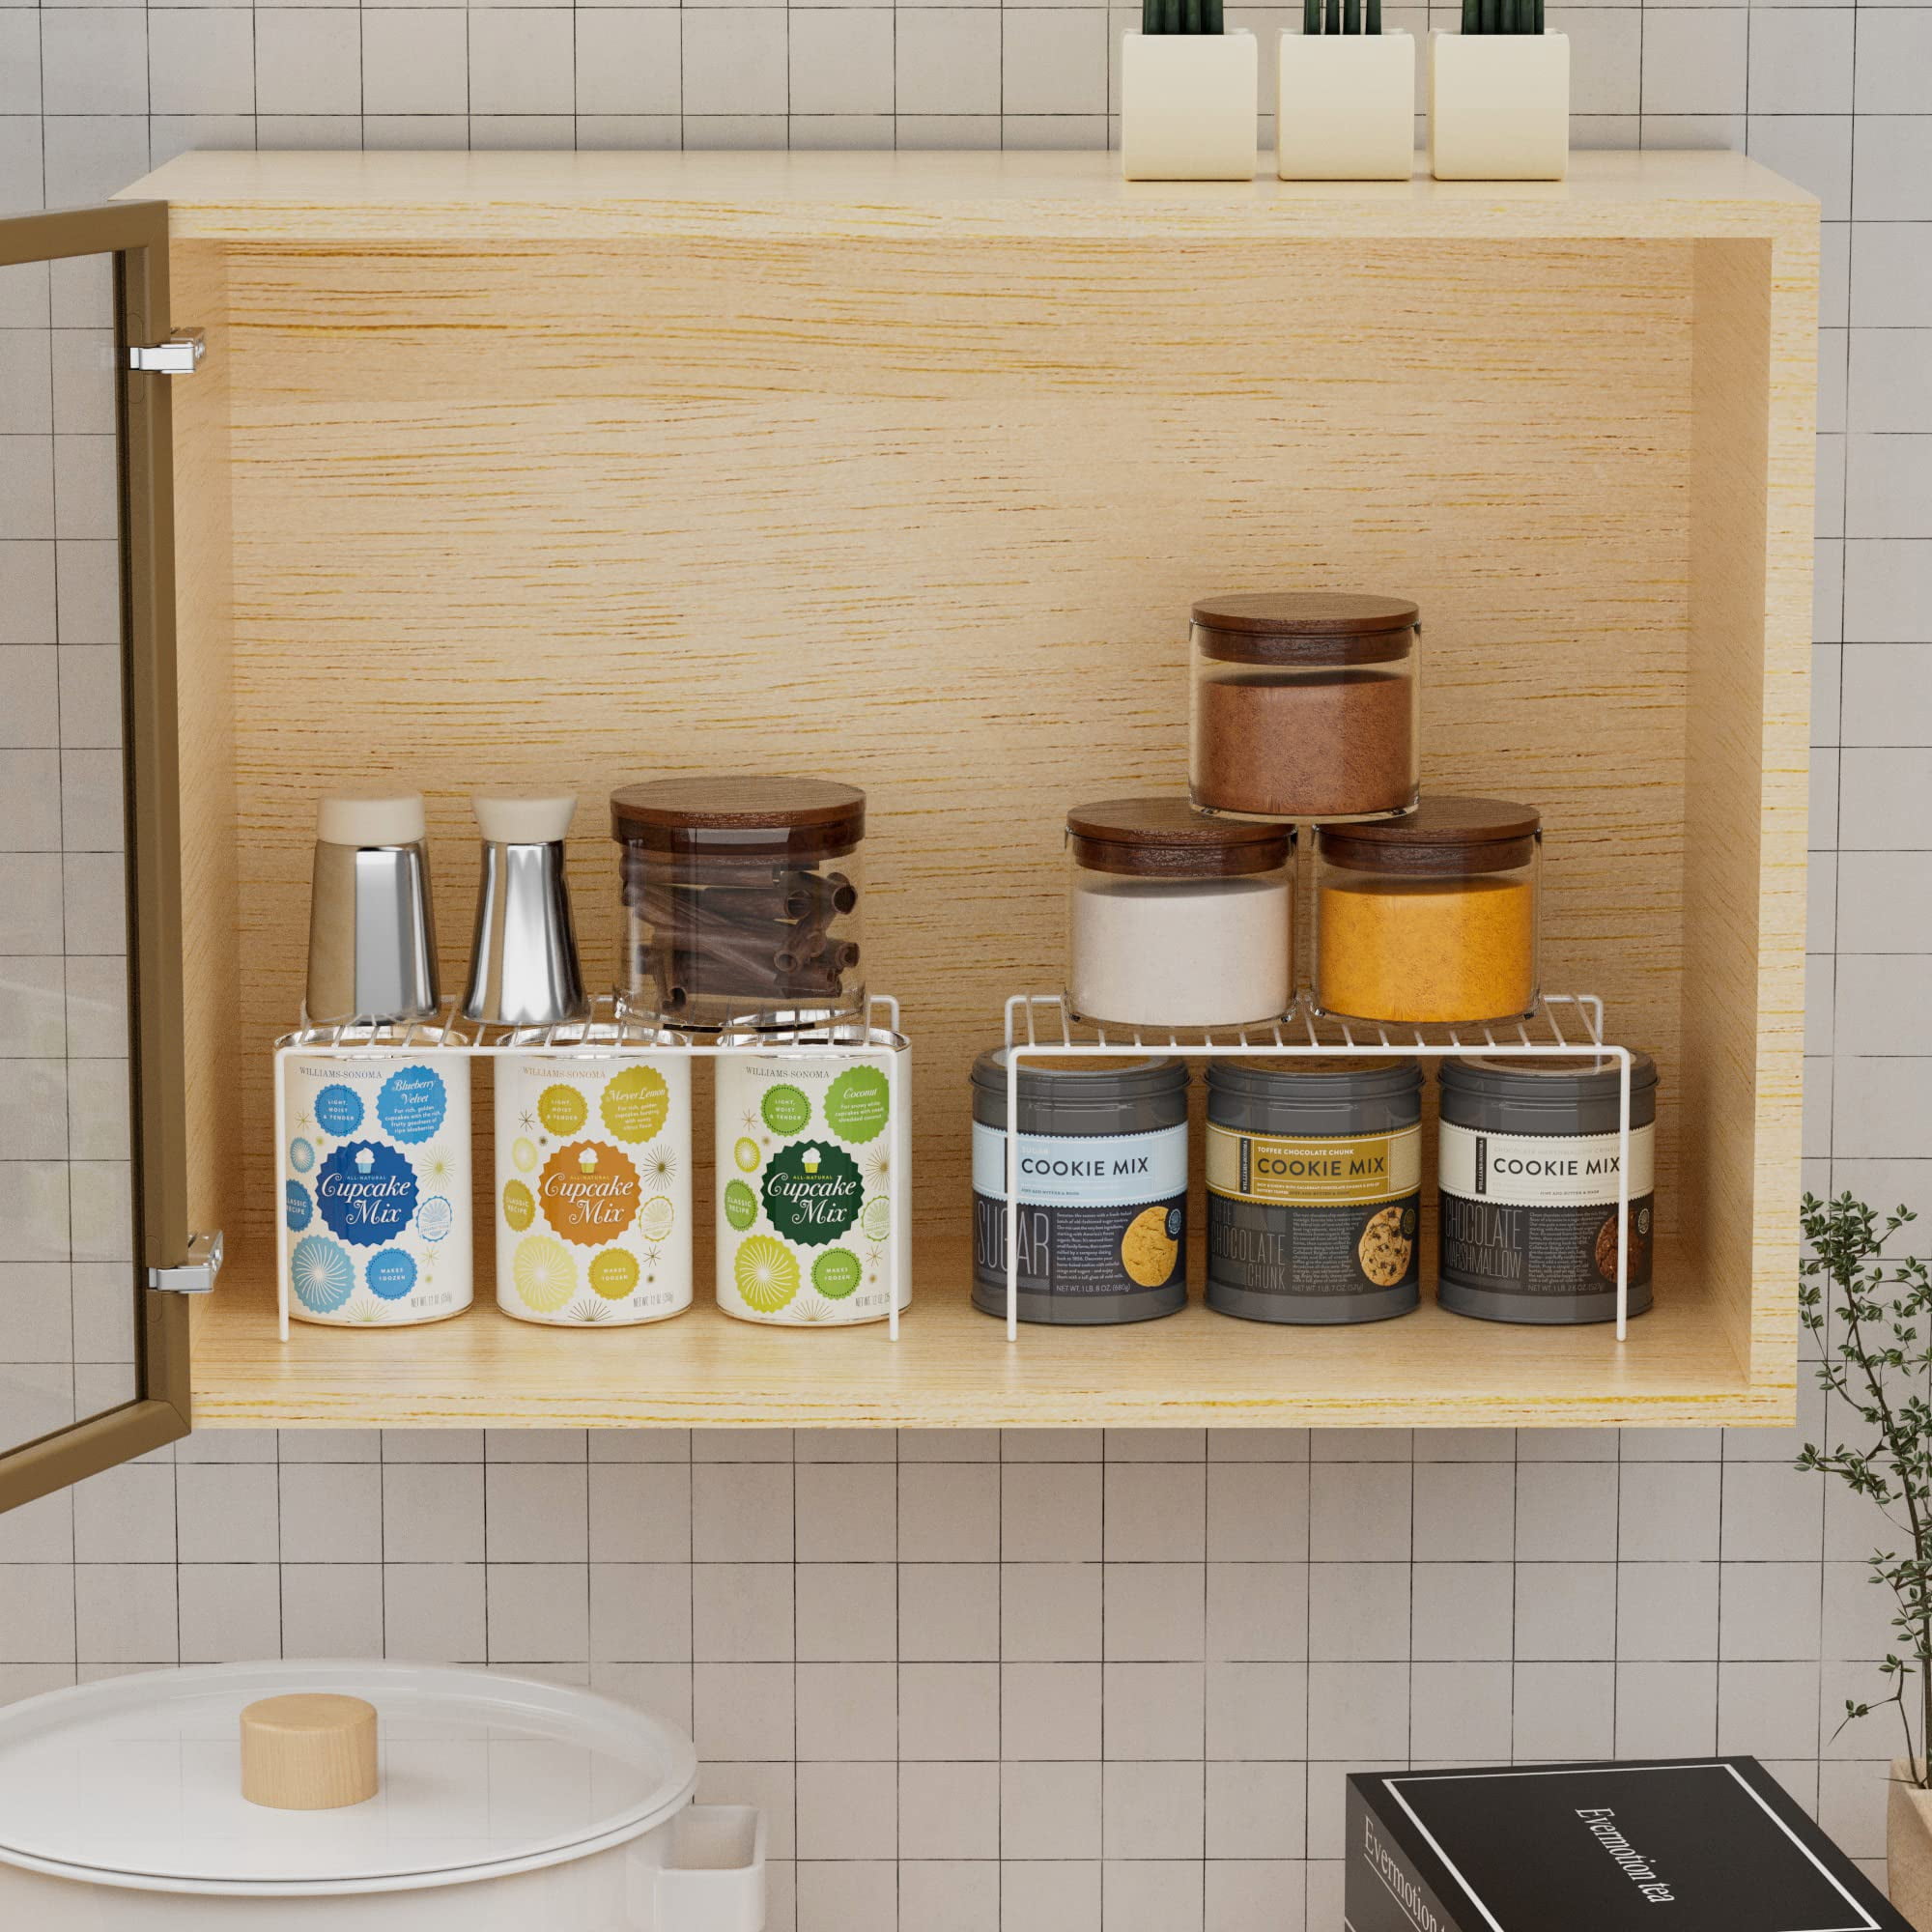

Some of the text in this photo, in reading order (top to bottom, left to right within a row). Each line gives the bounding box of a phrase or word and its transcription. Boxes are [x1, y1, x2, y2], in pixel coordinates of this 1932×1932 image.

[299, 1066, 383, 1079] WILLIAMS-SONOMA
[392, 1079, 436, 1092] Blueberry
[401, 1093, 430, 1105] Velvet
[1021, 1156, 1149, 1177] COOKIE MIX
[1258, 1156, 1384, 1177] COOKIE MIX
[1494, 1156, 1620, 1177] COOKIE MIX
[322, 1173, 411, 1204] Cupcake
[545, 1173, 634, 1204] Cupcake
[767, 1172, 857, 1204] Cupcake
[346, 1199, 402, 1225] Mix
[569, 1199, 625, 1225] Mix
[791, 1199, 847, 1225] Mix
[1446, 1198, 1522, 1250] CHOCOLATE
[978, 1201, 1049, 1276] SUGAR
[1212, 1221, 1287, 1265] CHOCOLATE
[1248, 1263, 1286, 1290] CHUNK
[1575, 1807, 1676, 1904] Evermotion tea
[1365, 1815, 1438, 1932] Evermotion
